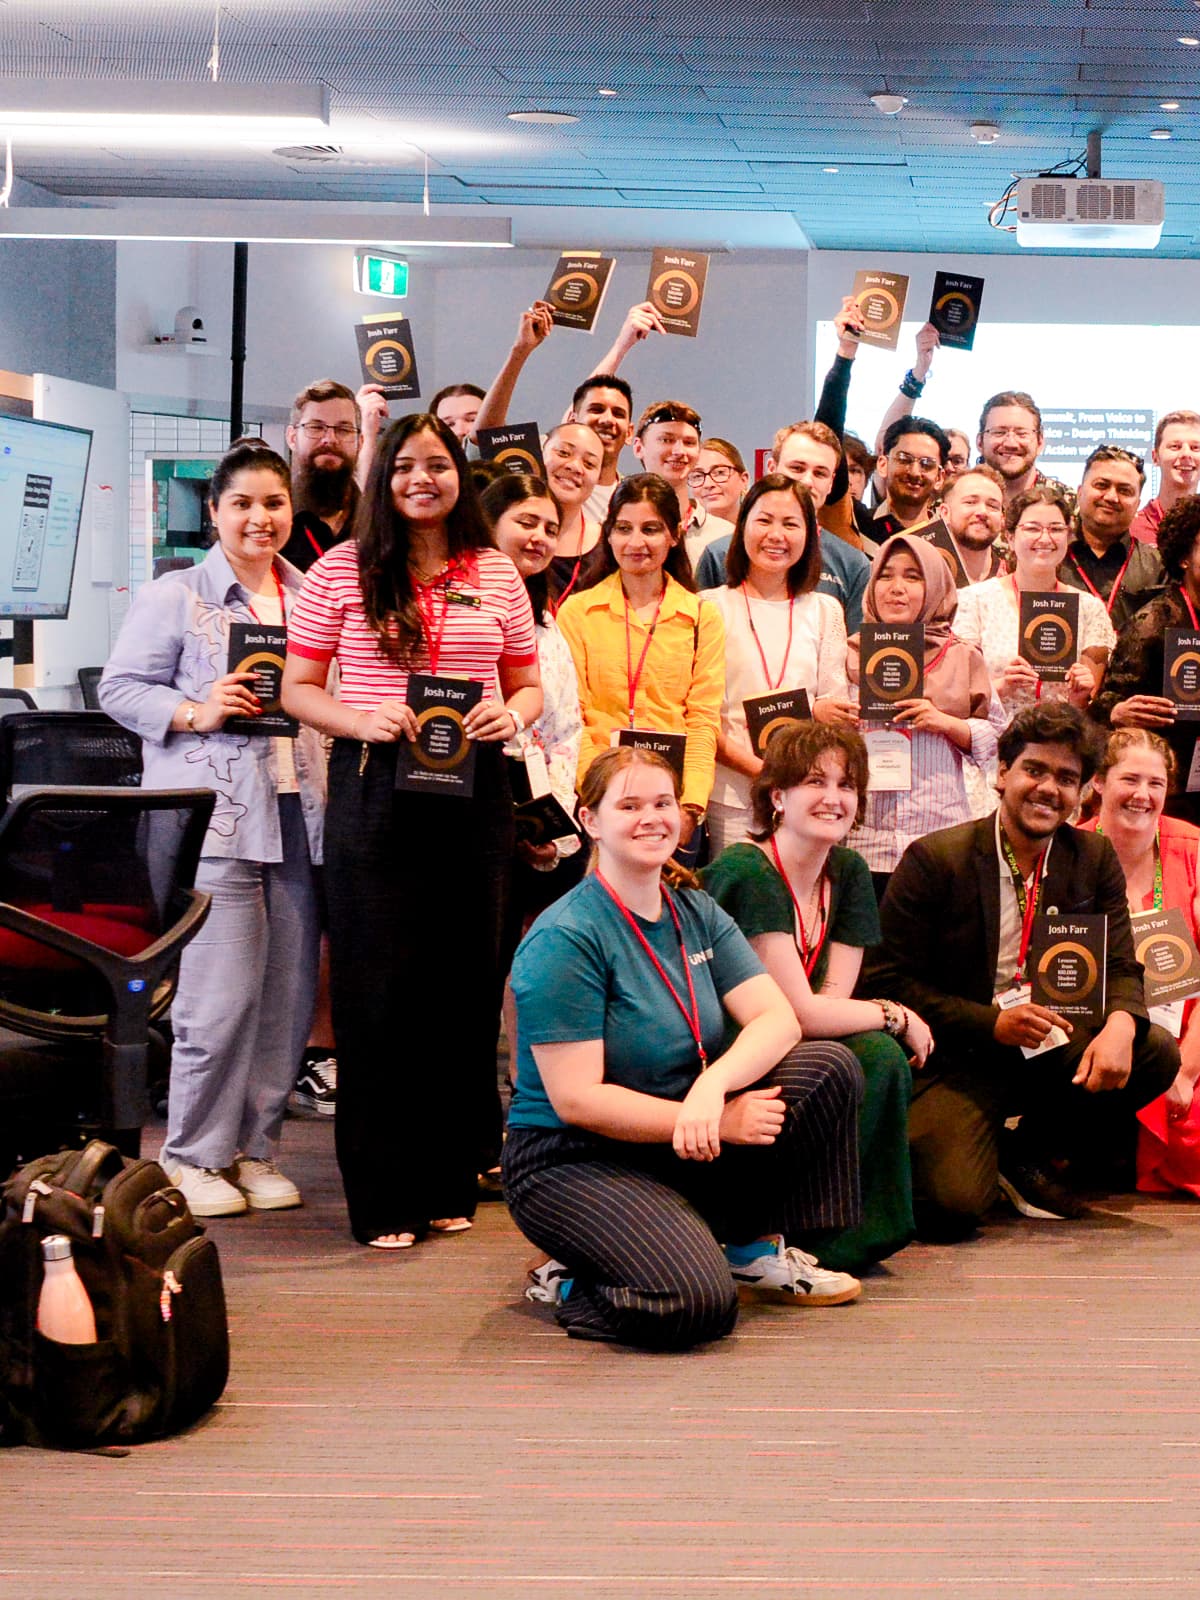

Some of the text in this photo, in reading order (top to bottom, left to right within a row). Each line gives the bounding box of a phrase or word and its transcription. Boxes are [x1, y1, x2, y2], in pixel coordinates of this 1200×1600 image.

[664, 256, 696, 267] Josh Farr
[945, 280, 973, 290] Josh Farr
[1105, 412, 1133, 423] Voice
[492, 433, 525, 445] Josh Farr
[1071, 428, 1105, 441] Design
[1106, 428, 1151, 442] Thinking
[1032, 600, 1066, 609] Josh Farr
[245, 634, 289, 646] Josh Farr
[874, 632, 911, 641] Josh Farr
[1178, 637, 1191, 646] Josh
[424, 686, 467, 700] Josh Farr
[758, 700, 795, 716] Josh Farr
[653, 743, 672, 752] Farr
[1048, 925, 1089, 935] Josh Farr
[1132, 919, 1169, 935] Josh Farr
